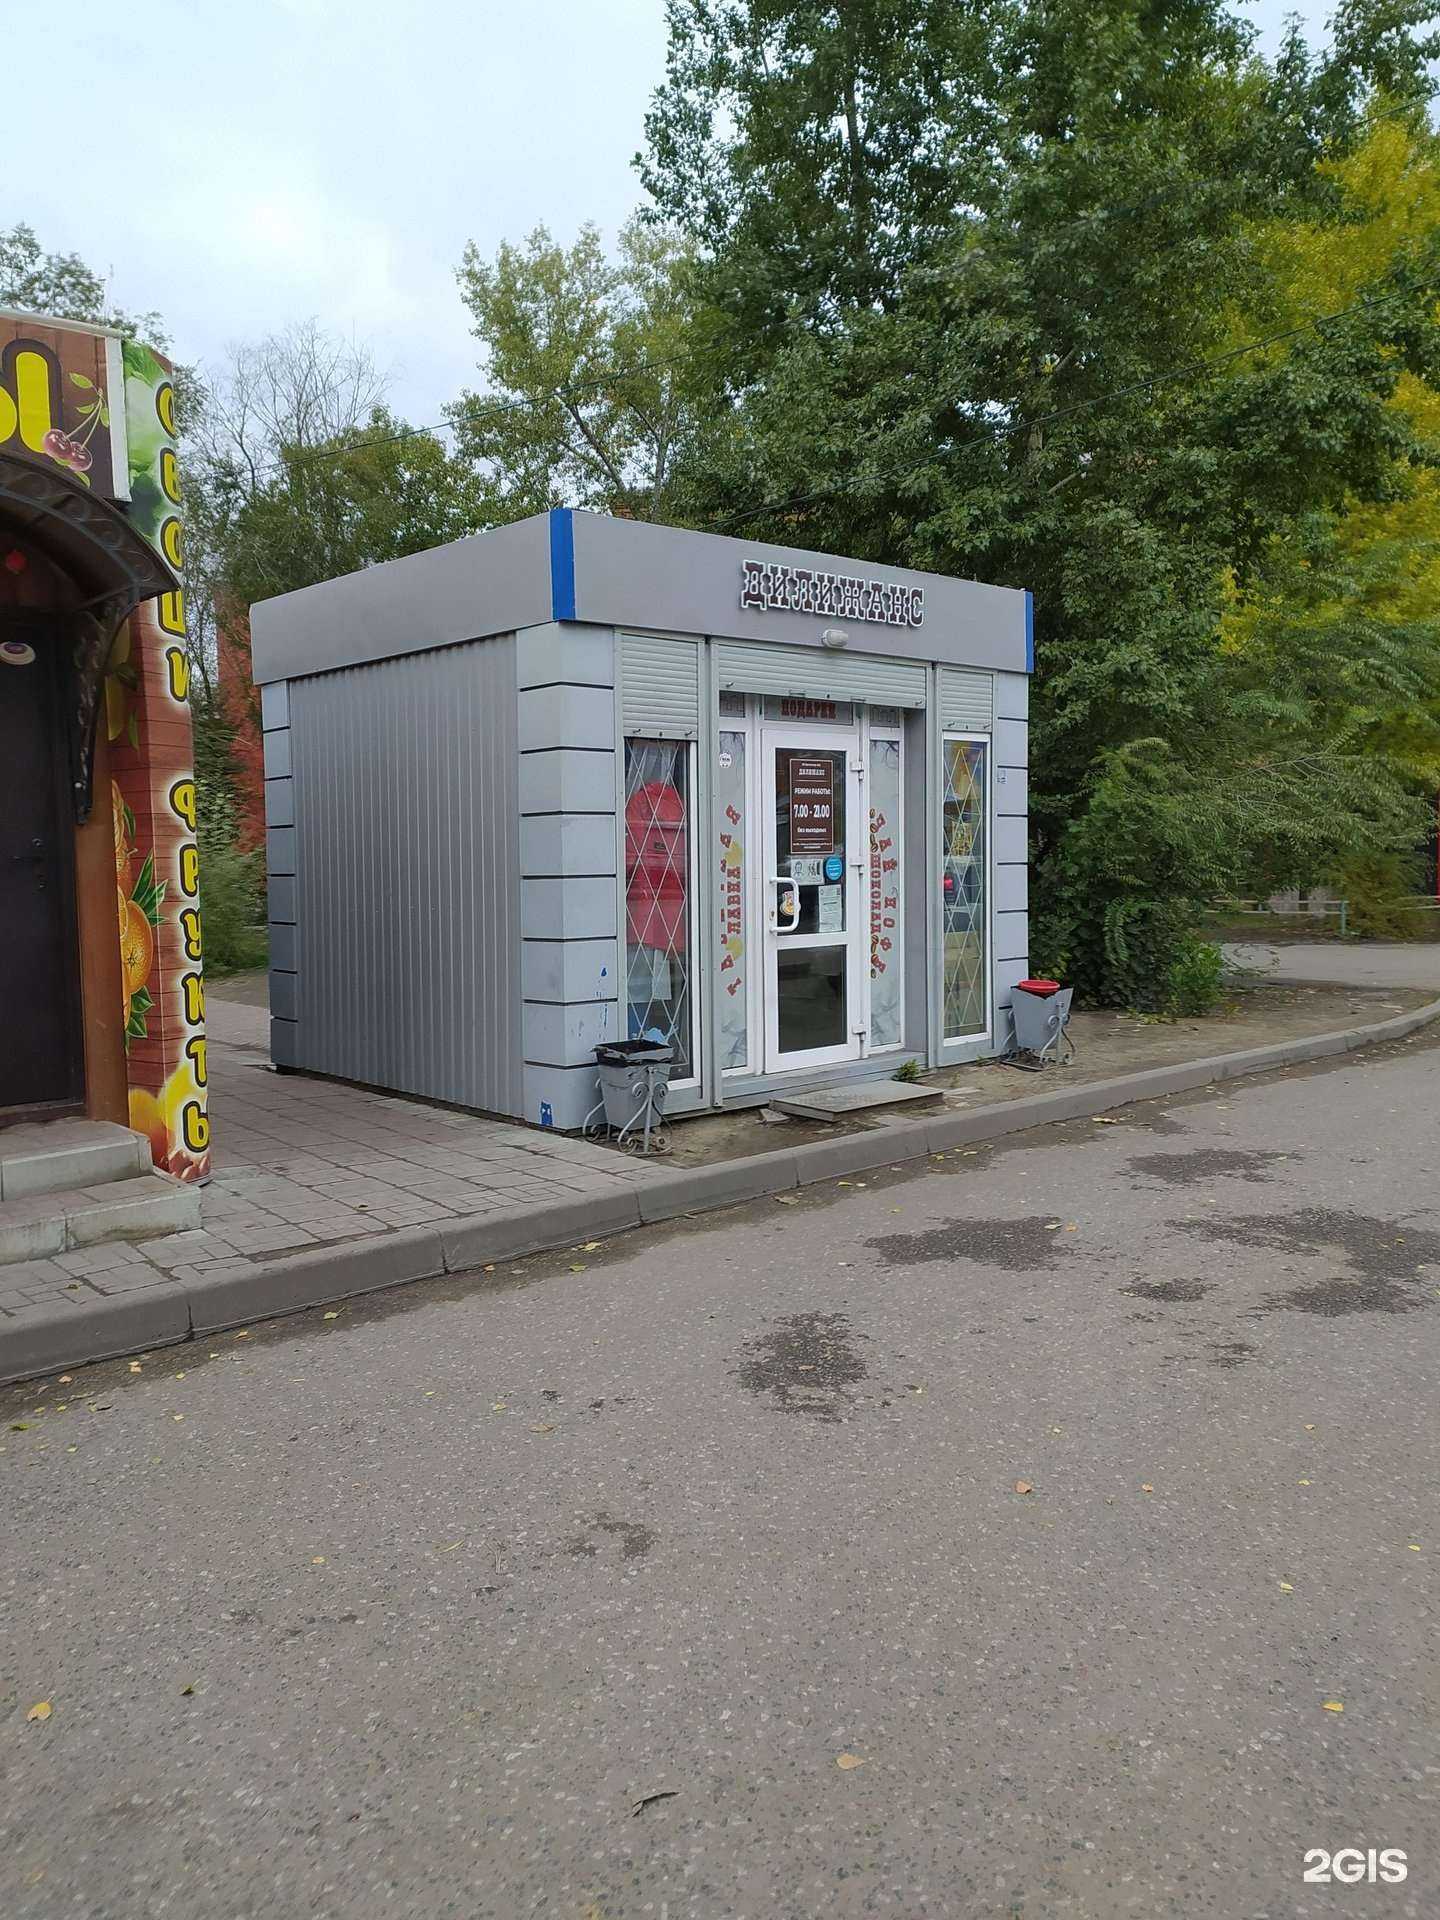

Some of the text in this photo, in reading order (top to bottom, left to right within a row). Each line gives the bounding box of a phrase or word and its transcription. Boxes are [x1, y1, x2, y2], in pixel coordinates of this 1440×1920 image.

[741, 560, 924, 626] ДИЛИЖАНС
[794, 787, 811, 796] РЕЖИМ
[794, 804, 808, 818] 7.00
[813, 804, 830, 818] 21.00
[727, 866, 741, 935] ЛАВКА
[870, 853, 882, 935] ШОКОЛАД
